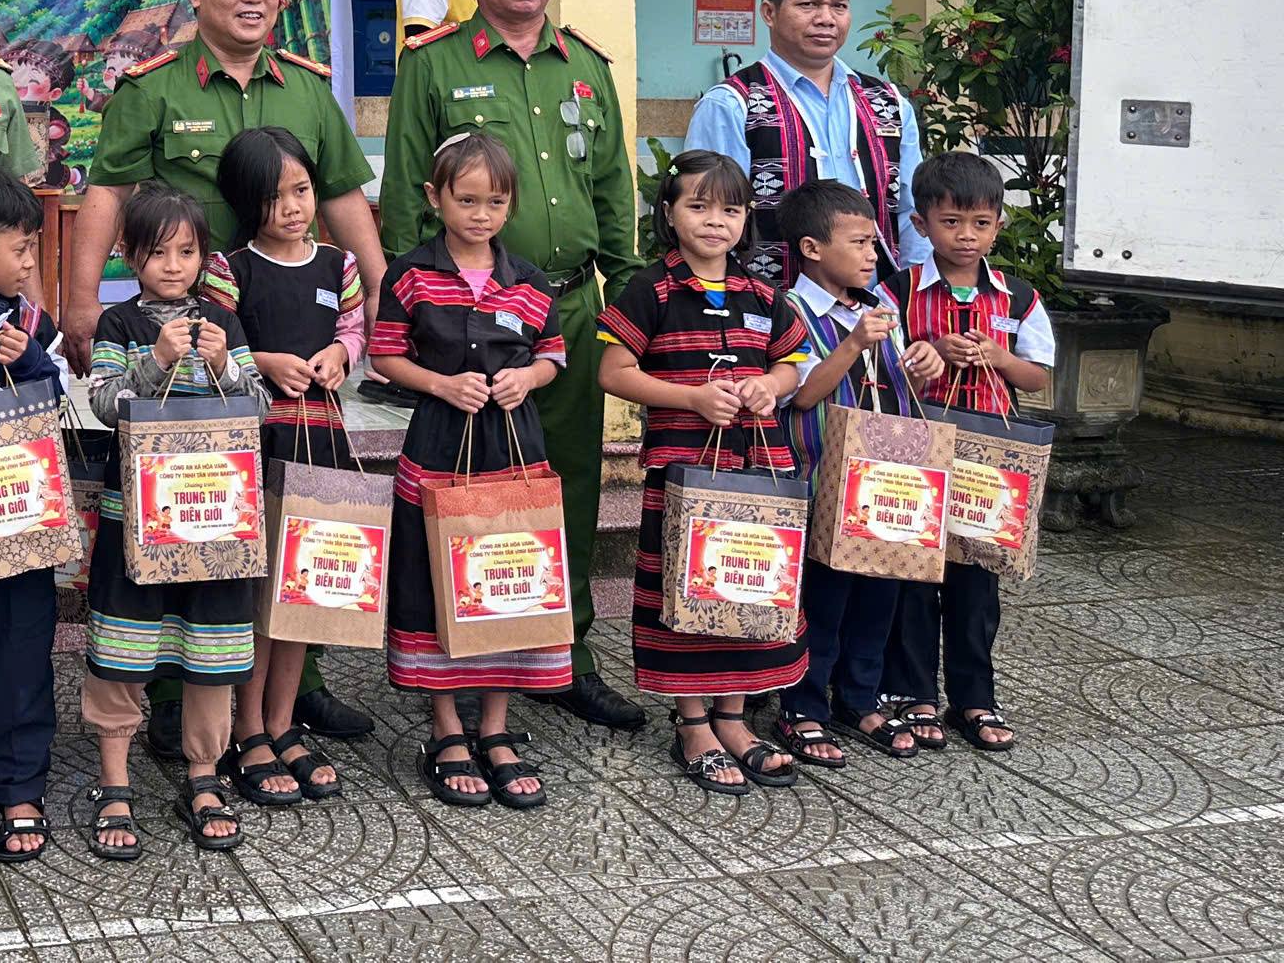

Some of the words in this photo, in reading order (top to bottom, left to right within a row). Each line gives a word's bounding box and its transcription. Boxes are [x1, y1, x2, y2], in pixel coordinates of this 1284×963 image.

[10, 481, 30, 496] THU
[174, 491, 205, 504] TRUNG
[208, 491, 226, 503] THU
[874, 495, 899, 508] TRUNG
[903, 499, 917, 511] THU
[8, 498, 27, 515] GIỚI
[180, 507, 200, 522] BIÊN
[204, 506, 222, 521] GIỚI
[313, 557, 339, 571] TRUNG
[342, 560, 357, 573] THU
[721, 555, 749, 569] TRUNG
[753, 559, 770, 571] THU
[484, 567, 514, 580] TRUNG
[517, 565, 534, 578] THU
[724, 570, 743, 584] BIÊN
[747, 573, 764, 587] GIỚI
[490, 581, 510, 596] BIÊN
[513, 580, 531, 594] GIỚI
